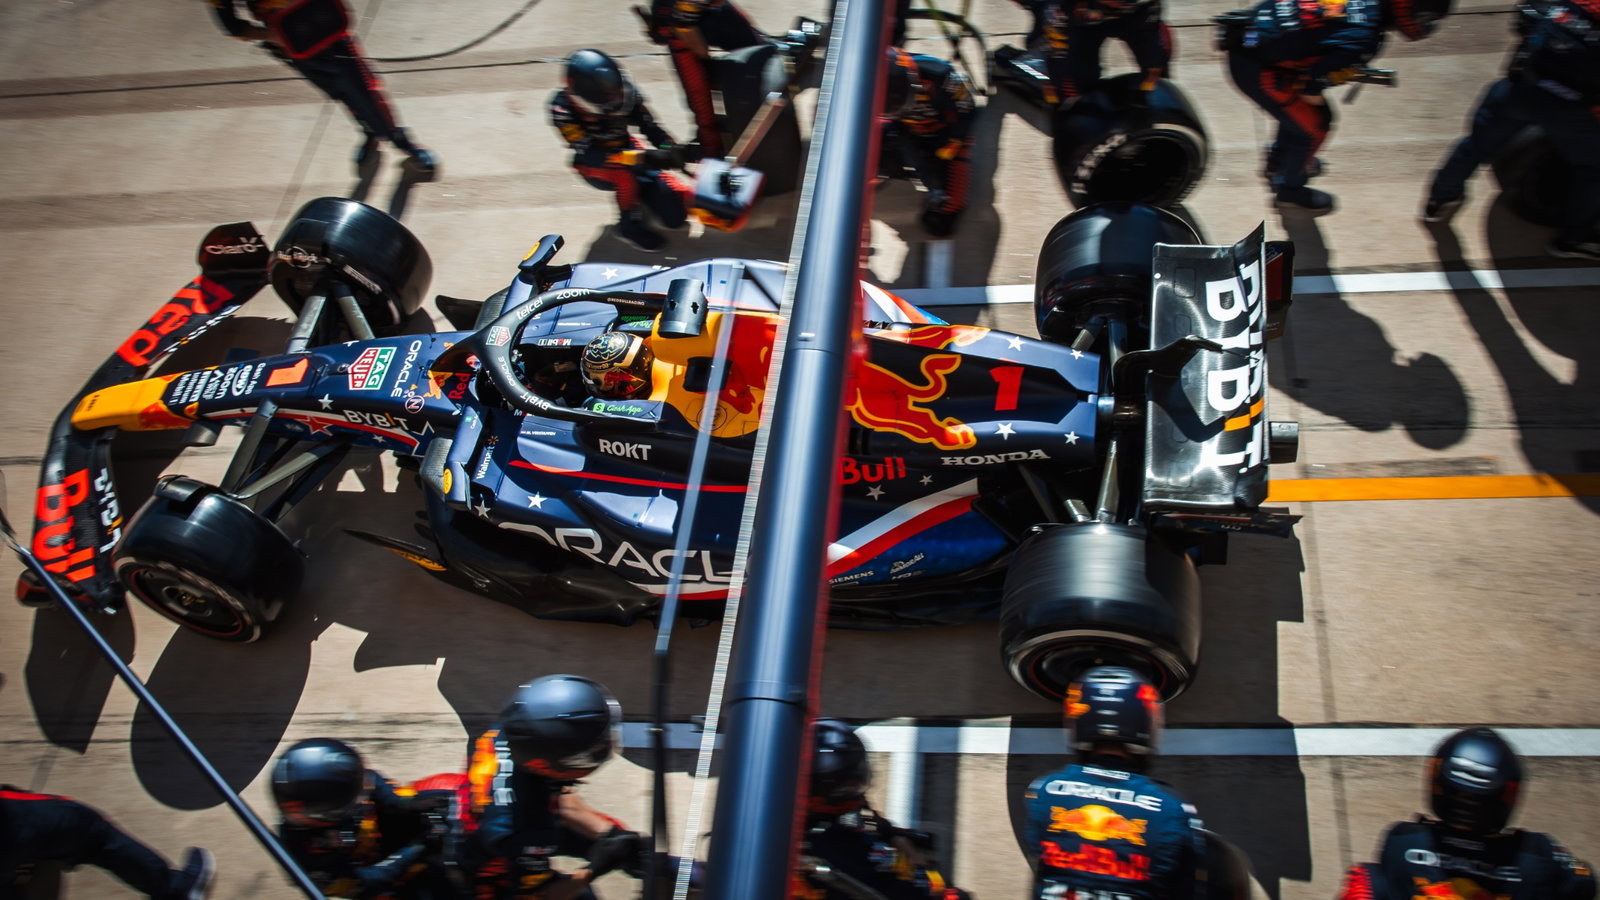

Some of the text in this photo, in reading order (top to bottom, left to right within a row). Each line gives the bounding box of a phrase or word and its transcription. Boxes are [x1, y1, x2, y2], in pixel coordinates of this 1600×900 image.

[204, 241, 262, 254] Claro
[516, 297, 543, 320] telcel
[556, 288, 591, 300] zoom
[116, 275, 236, 367] Red
[266, 357, 310, 388] 1
[353, 350, 377, 388] HEUER
[368, 350, 391, 386] TAG
[390, 340, 422, 397] ORACLE
[214, 366, 239, 400] zoom
[447, 373, 471, 399] Red
[989, 366, 1025, 412] 1
[520, 391, 550, 411] BYBIT
[342, 409, 409, 430] BYBIT
[476, 445, 495, 479] Walmart
[599, 438, 651, 461] ROKT
[941, 449, 1051, 466] HONDA
[838, 457, 906, 485] Bull
[31, 468, 96, 583] Bull
[828, 570, 875, 584] SIEMENS
[1045, 779, 1163, 812] ORACLE
